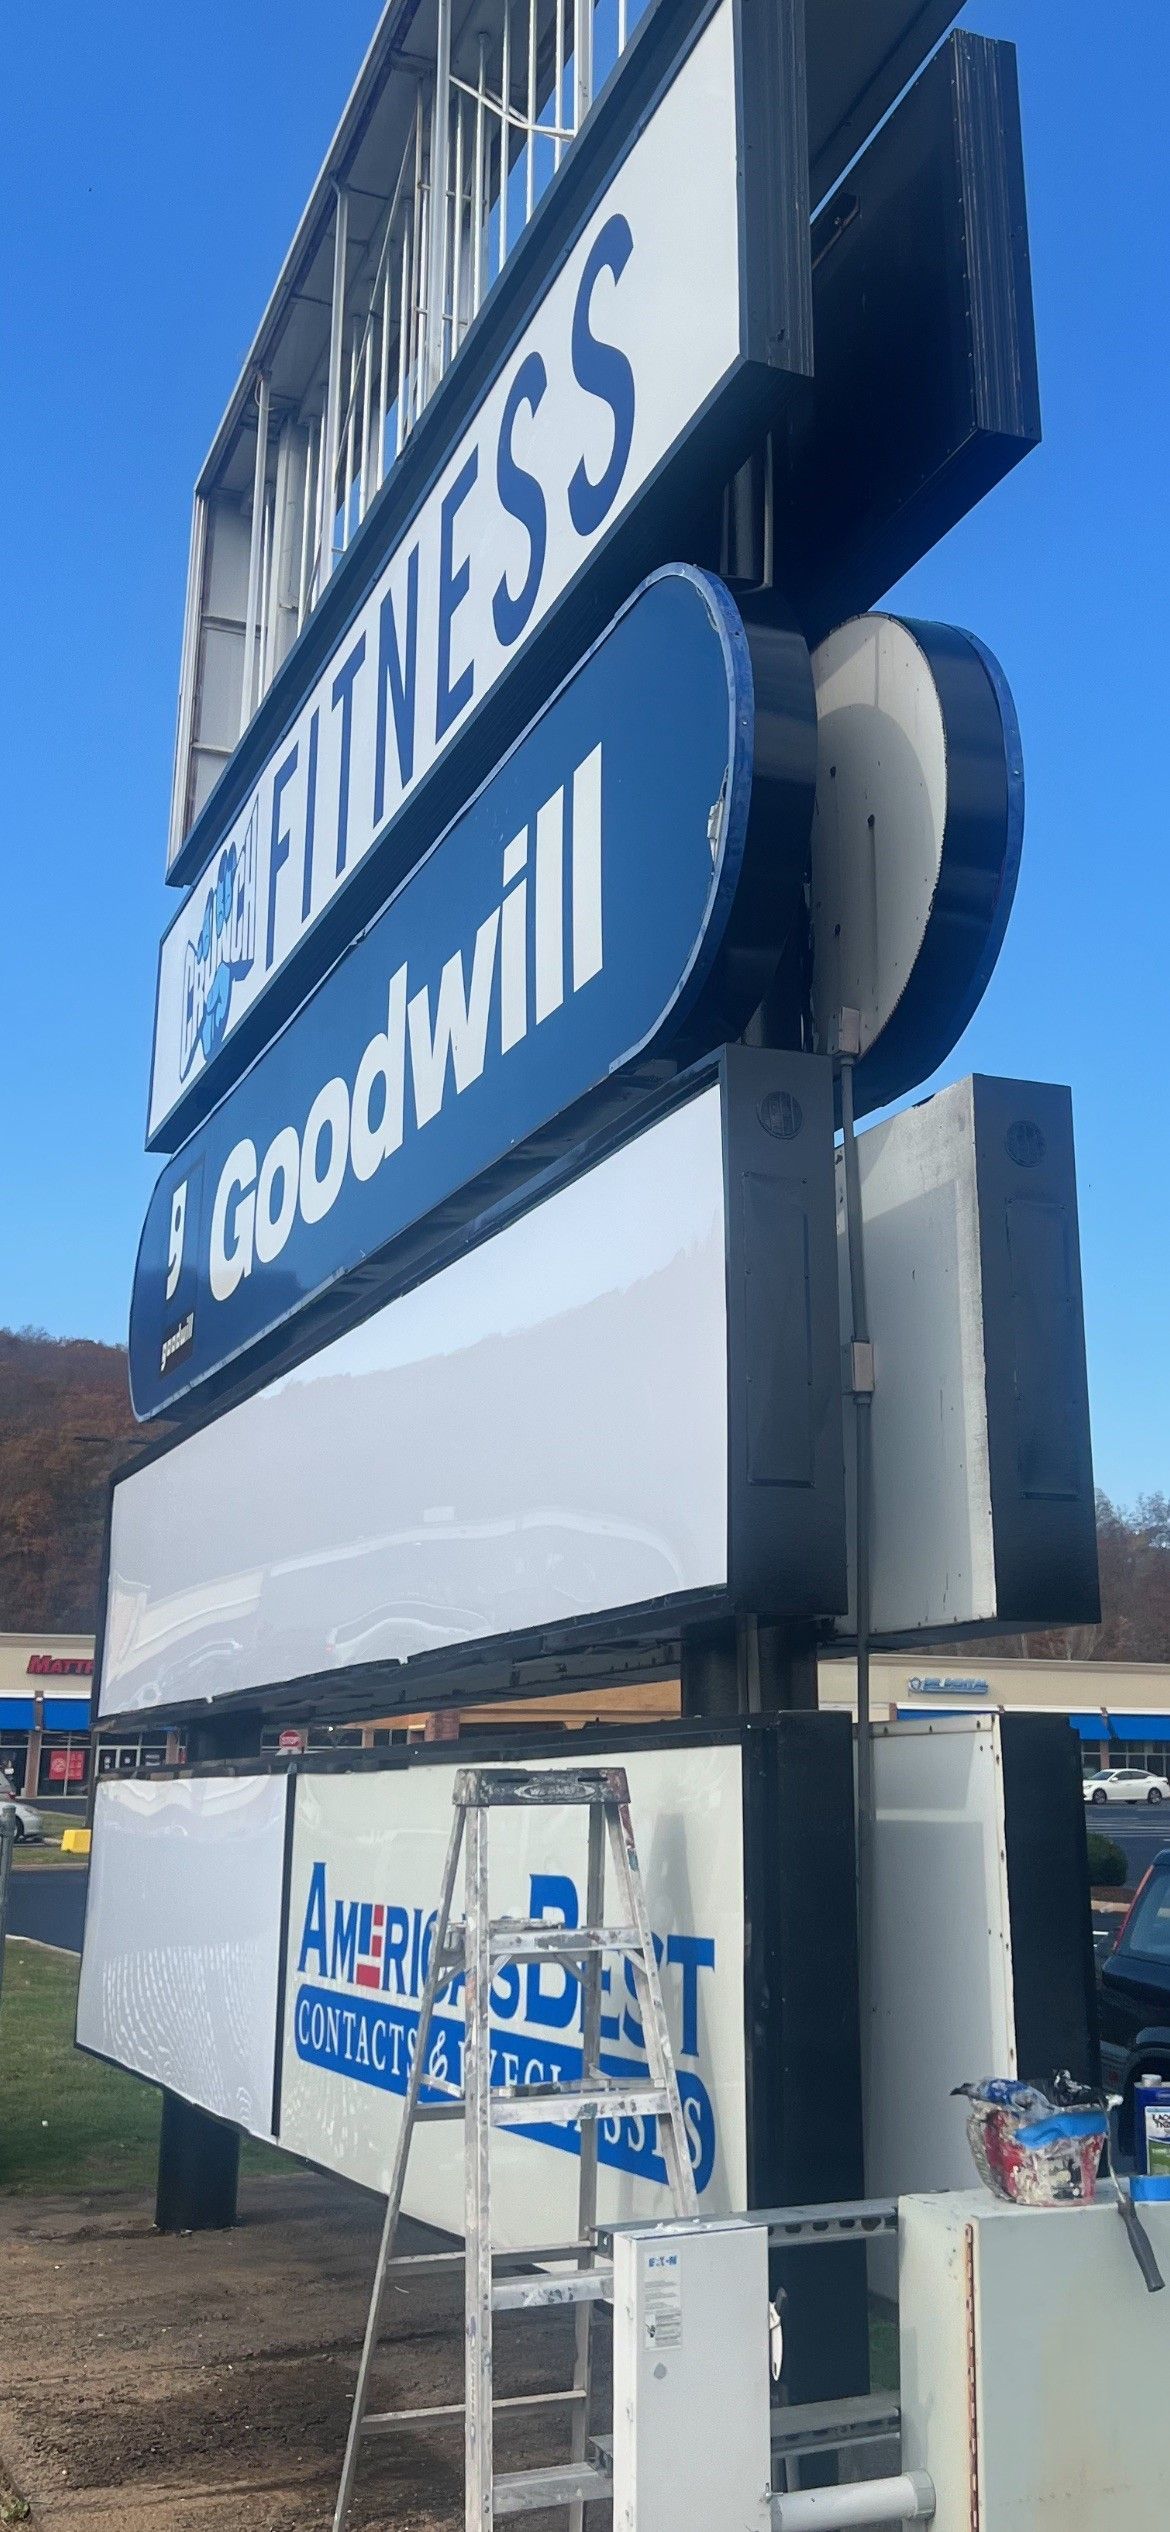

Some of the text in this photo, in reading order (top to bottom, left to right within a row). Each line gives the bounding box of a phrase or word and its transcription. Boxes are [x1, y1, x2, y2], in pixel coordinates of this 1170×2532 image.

[266, 213, 634, 972] FITNESS
[209, 741, 603, 1301] Goodwill
[160, 1312, 195, 1371] goodwill
[297, 1999, 418, 2080] CONTACTS
[428, 2030, 449, 2084] &
